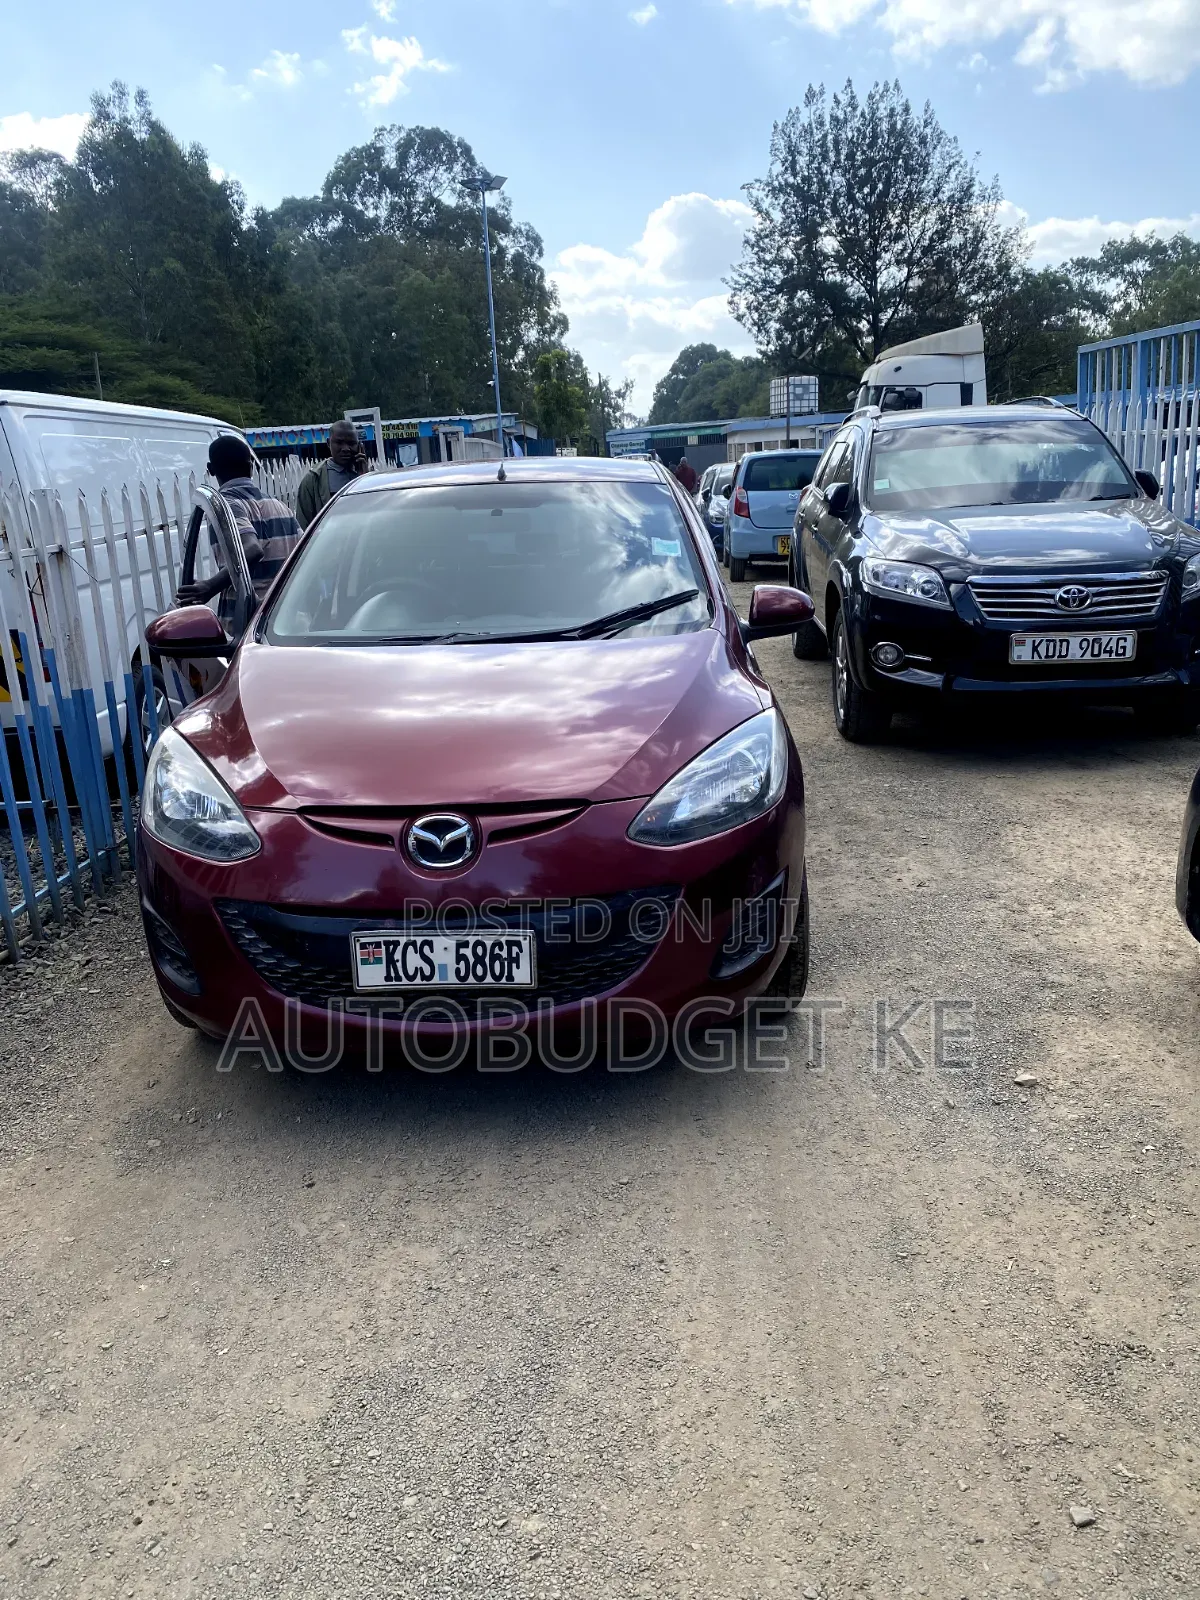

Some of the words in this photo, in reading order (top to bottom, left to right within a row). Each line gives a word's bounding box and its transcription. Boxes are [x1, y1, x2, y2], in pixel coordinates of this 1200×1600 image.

[252, 430, 308, 447] AUTOS
[311, 428, 331, 443] LT
[1031, 638, 1071, 660] KDD
[1078, 636, 1128, 659] 904G
[383, 939, 436, 983] KCS
[454, 939, 524, 983] 586F
